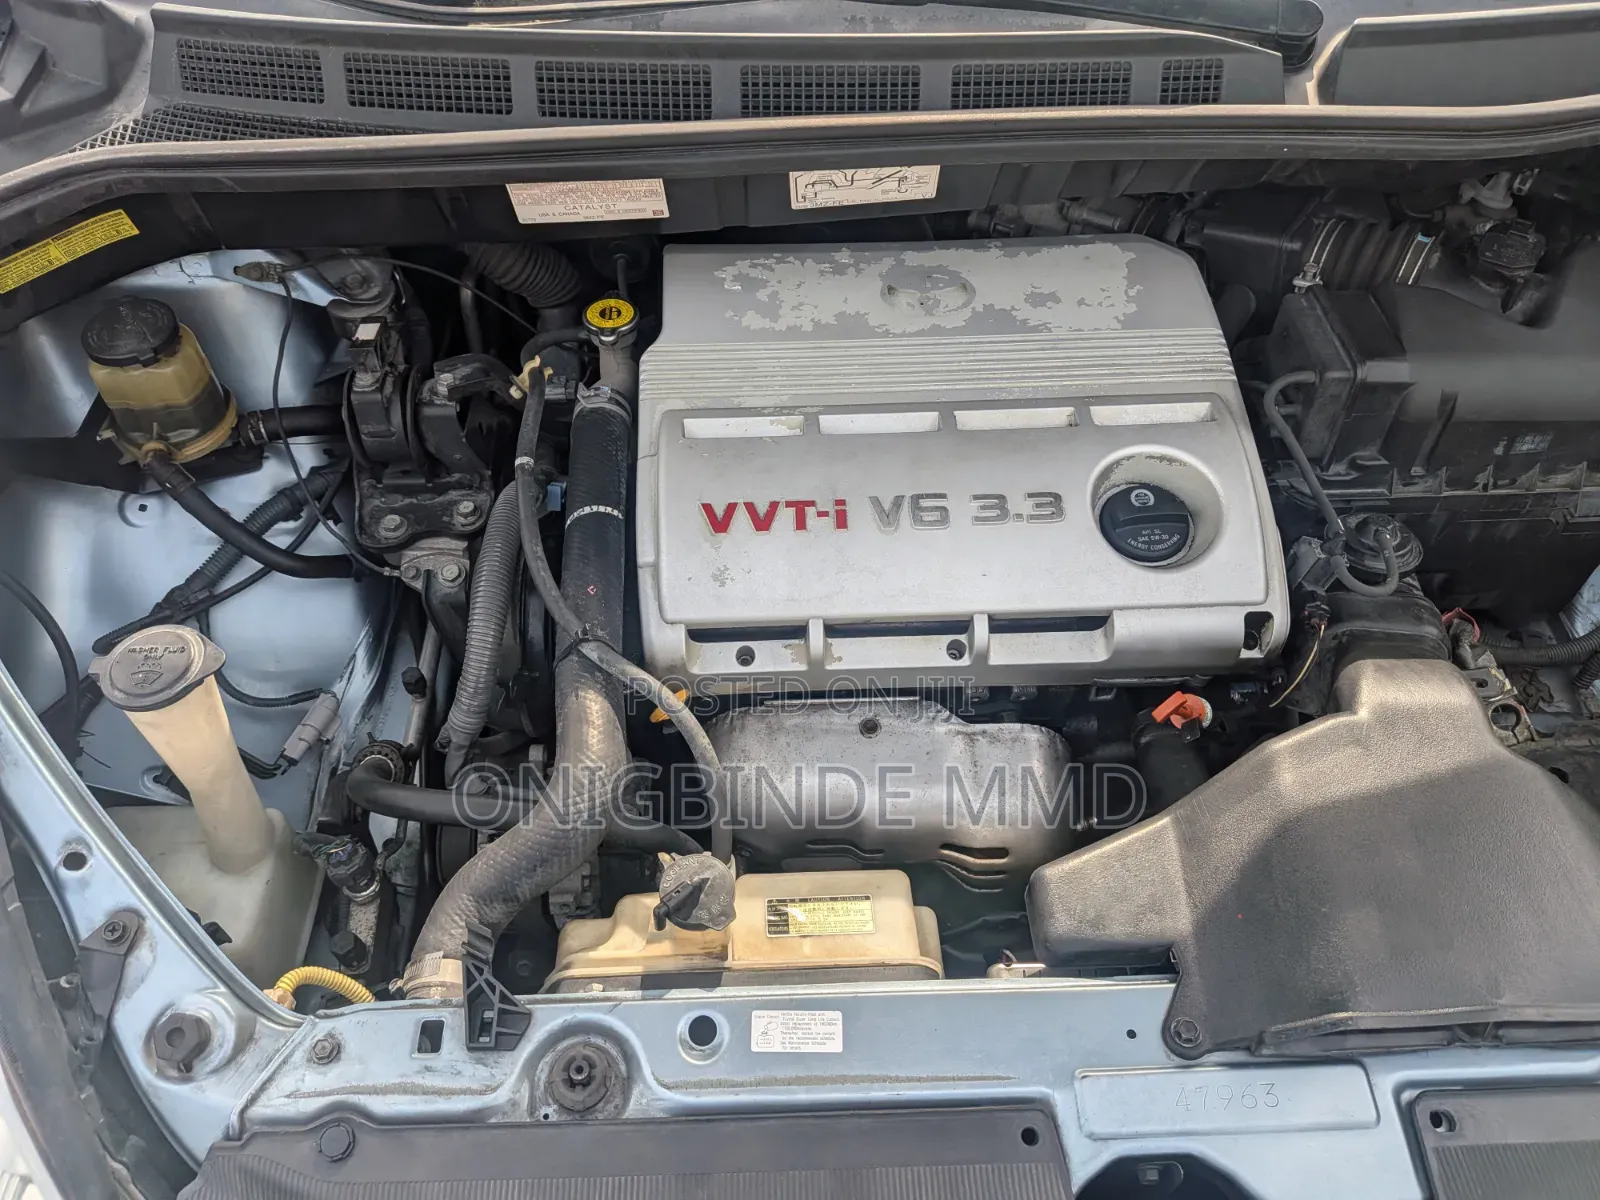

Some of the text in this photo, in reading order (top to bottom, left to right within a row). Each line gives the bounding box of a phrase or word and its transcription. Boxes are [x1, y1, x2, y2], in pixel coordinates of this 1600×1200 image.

[564, 203, 618, 211] CATALYST
[700, 491, 1066, 535] VVT-i V6 3.3
[1127, 533, 1181, 551] ENERGY CONSERVING
[163, 646, 187, 654] FLUID
[663, 856, 703, 889] COOLANT
[1175, 1083, 1279, 1111] 47963
